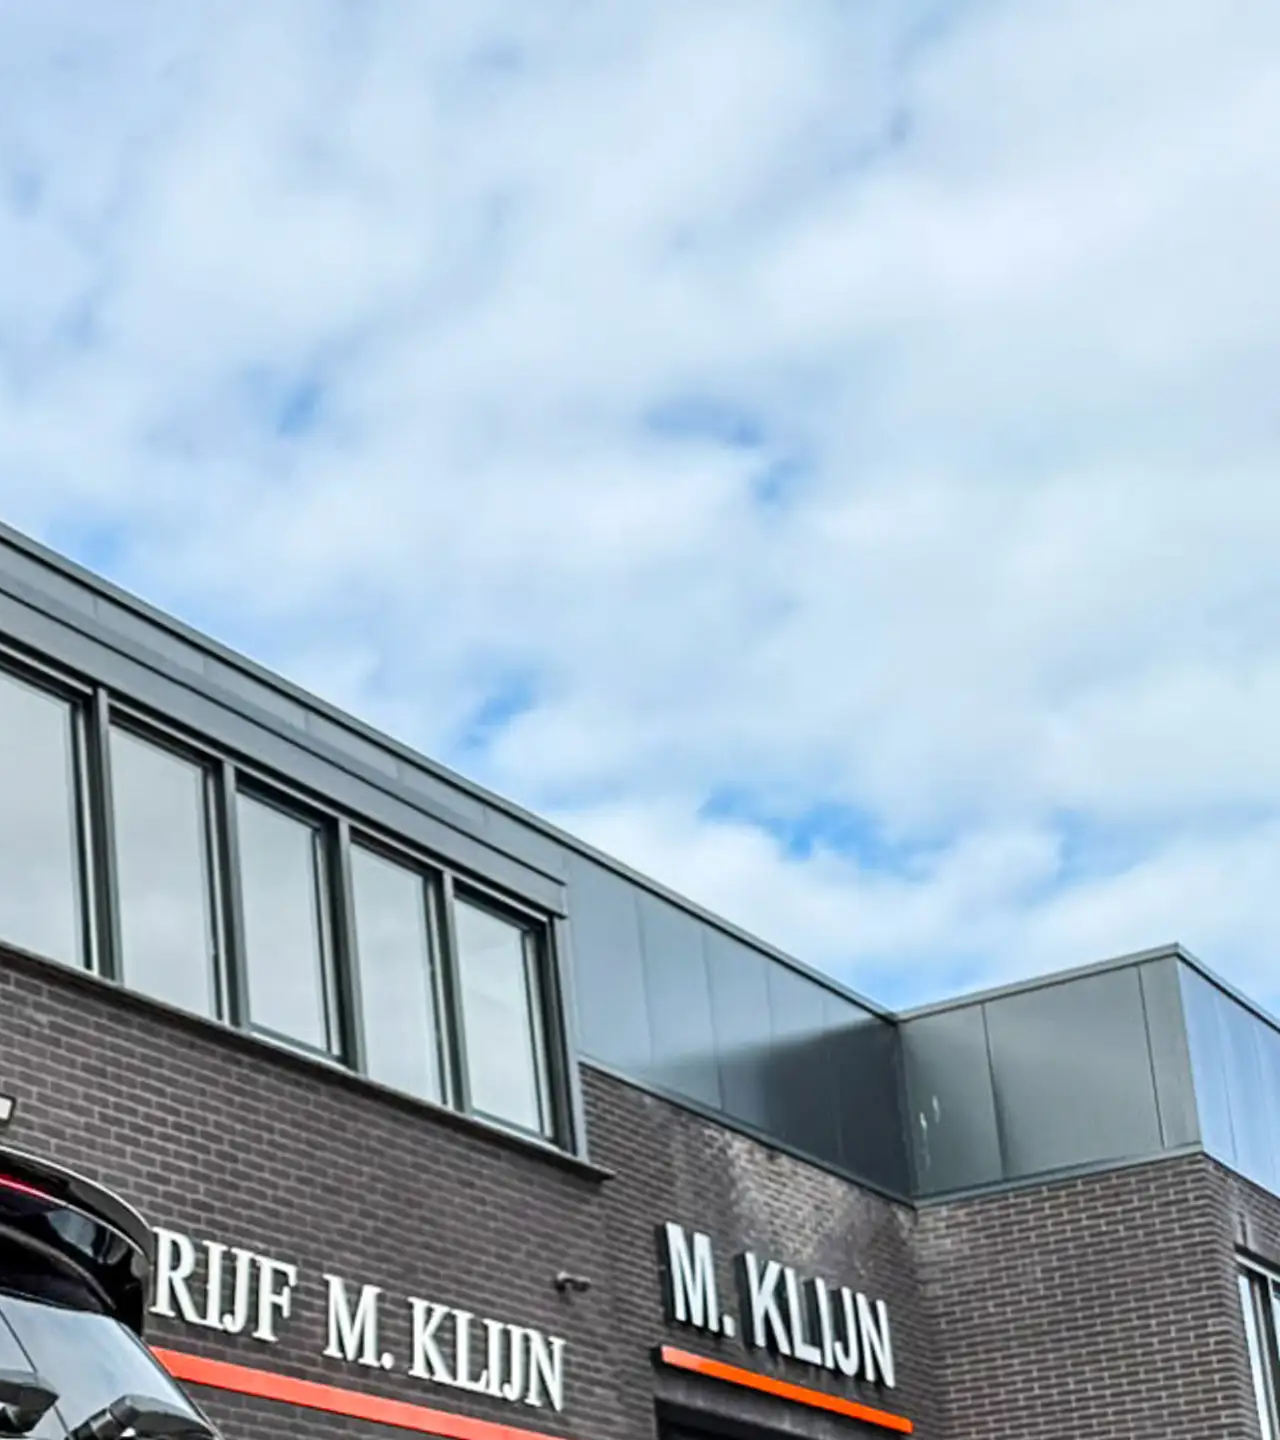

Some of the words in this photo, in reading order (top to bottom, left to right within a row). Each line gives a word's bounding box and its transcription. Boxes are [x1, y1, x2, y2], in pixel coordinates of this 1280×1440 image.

[322, 1274, 395, 1369] M.
[408, 1296, 566, 1412] KLIJN
[666, 1221, 735, 1338] M.
[745, 1252, 895, 1388] KLIJN
